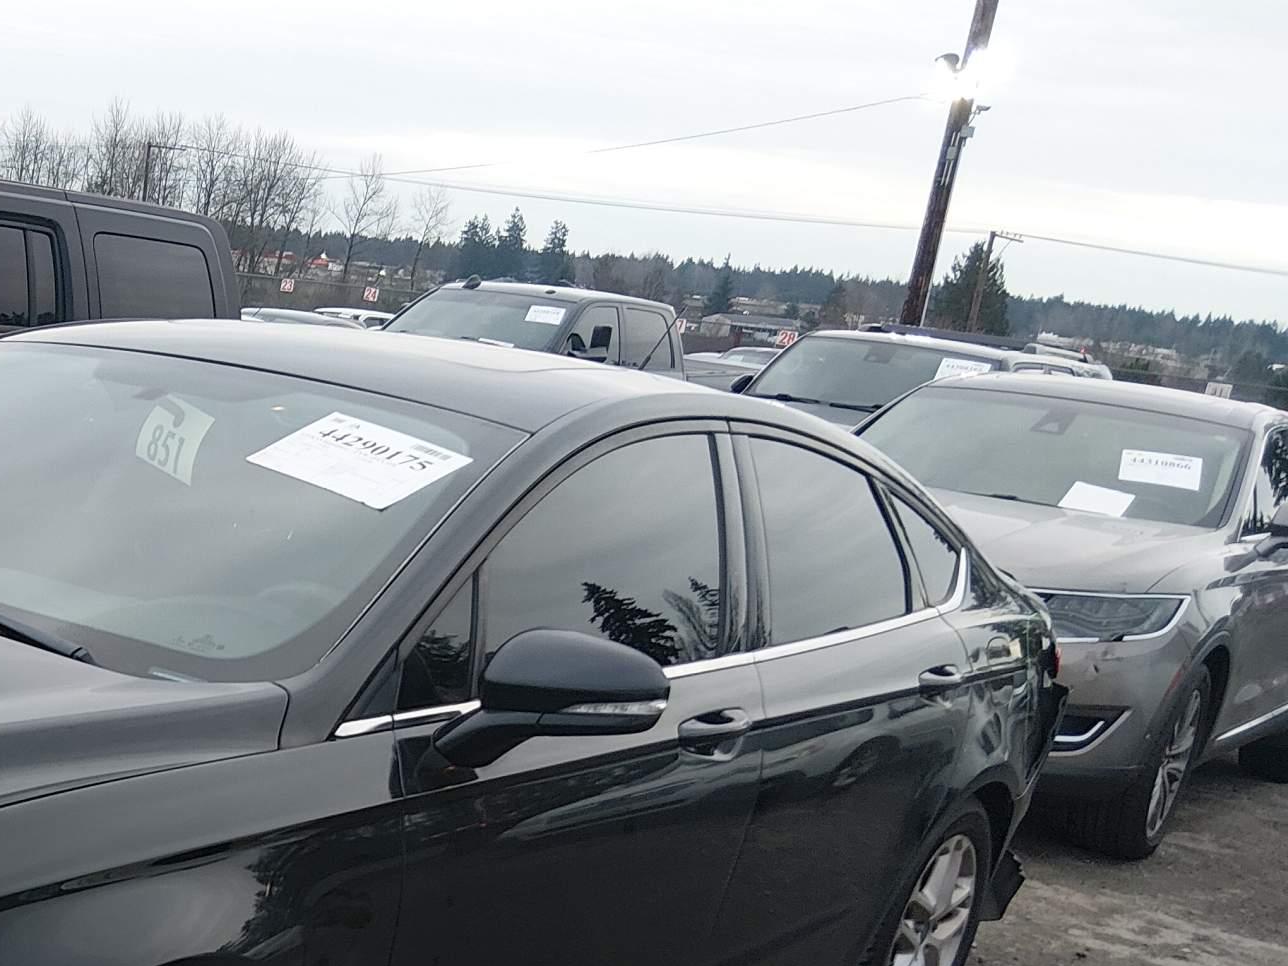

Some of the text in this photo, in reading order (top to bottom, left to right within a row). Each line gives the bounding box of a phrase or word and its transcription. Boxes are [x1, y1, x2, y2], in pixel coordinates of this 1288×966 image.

[281, 280, 293, 291] 23
[366, 287, 378, 301] 24
[779, 331, 797, 346] 28
[147, 424, 186, 475] 851
[319, 428, 434, 472] 44290175
